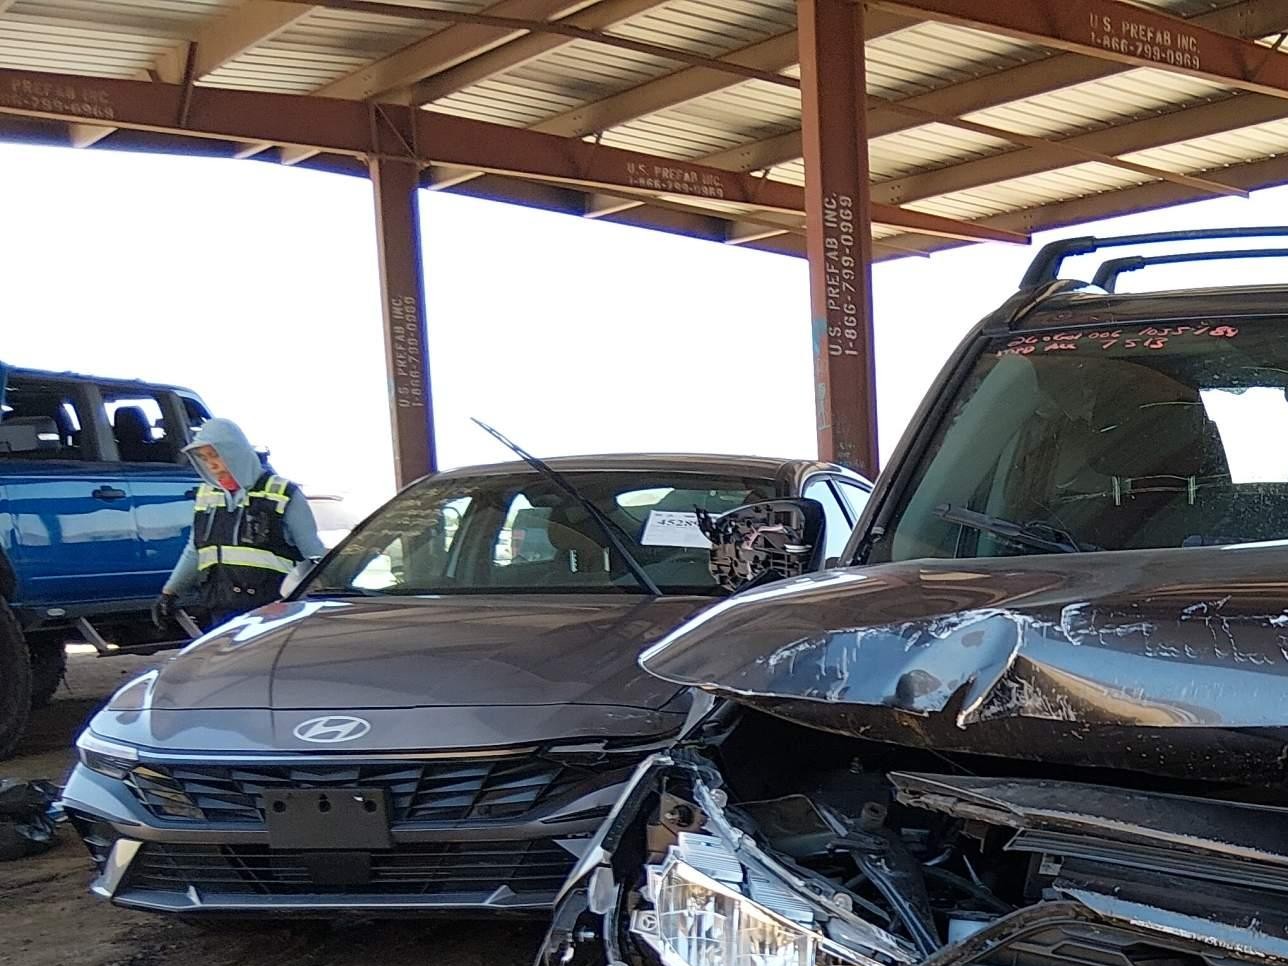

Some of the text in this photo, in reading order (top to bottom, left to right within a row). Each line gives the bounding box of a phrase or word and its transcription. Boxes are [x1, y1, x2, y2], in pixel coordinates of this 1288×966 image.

[1090, 32, 1201, 70] 1-866-799-0969
[1121, 21, 1172, 46] PREFAB
[1177, 33, 1200, 54] INC.
[654, 165, 698, 183] PREFAB
[824, 192, 843, 356] U.S. PREFAB INC.
[840, 195, 859, 356] 1-866-799-0969
[393, 326, 409, 376] PREFAB
